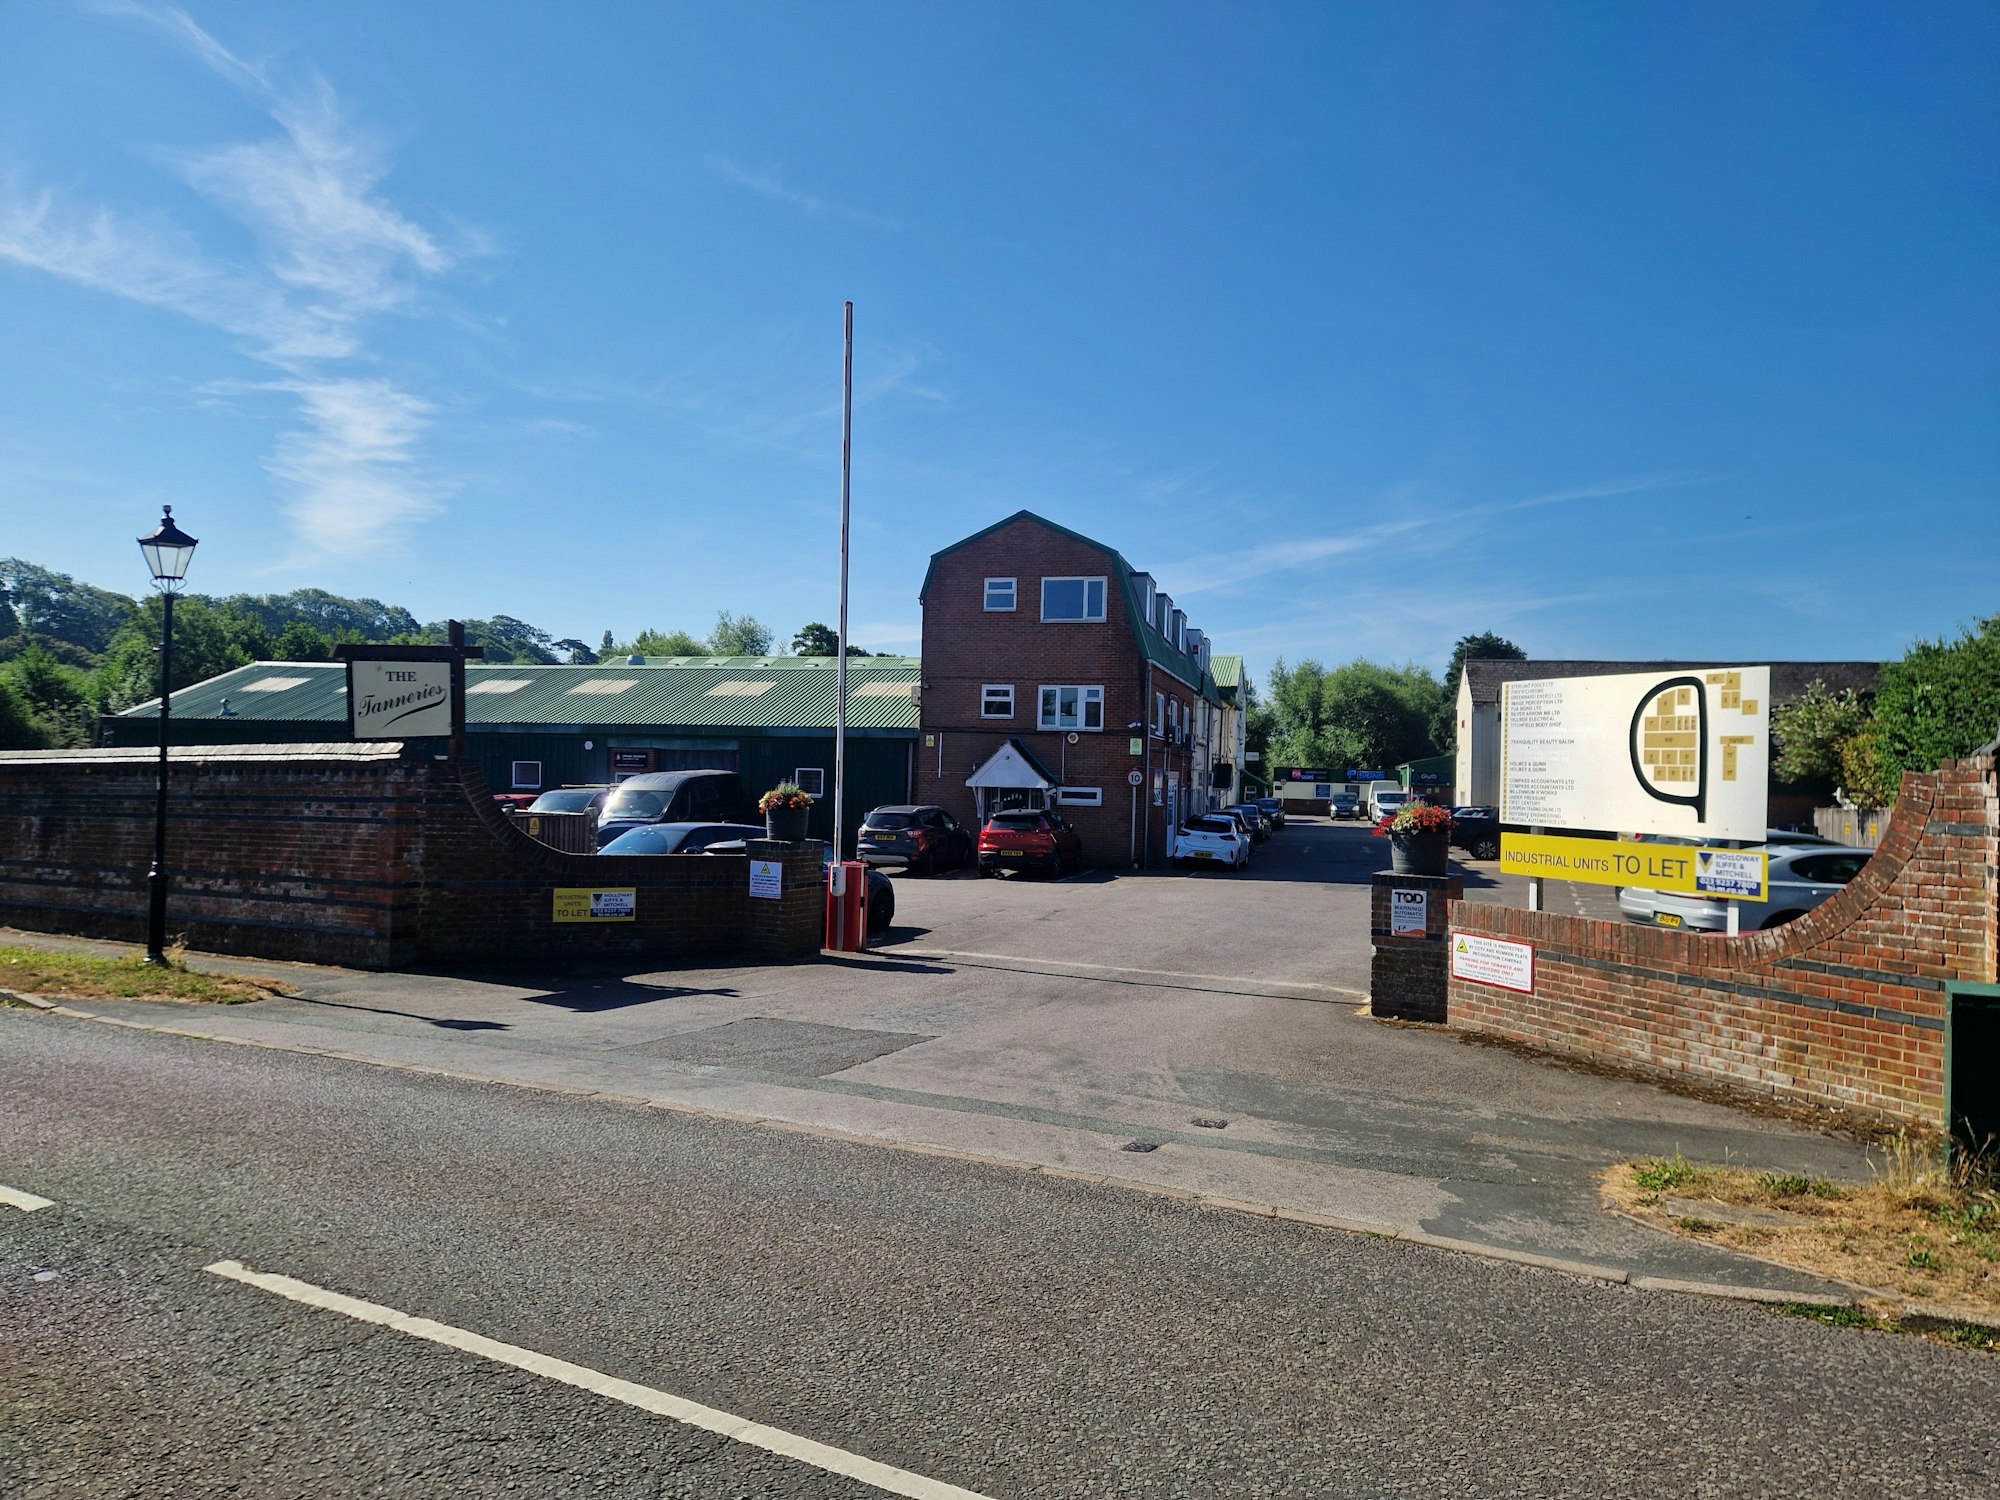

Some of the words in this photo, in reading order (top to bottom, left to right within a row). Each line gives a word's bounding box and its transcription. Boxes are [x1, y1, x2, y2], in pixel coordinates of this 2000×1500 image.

[385, 671, 416, 682] THE
[358, 683, 446, 718] Tanneries
[1130, 774, 1140, 782] 10
[1505, 851, 1570, 868] INDUSTRIAL
[1573, 858, 1609, 872] UNITS
[1612, 854, 1640, 874] TO
[1648, 858, 1688, 878] LET
[1716, 861, 1737, 870] ILIFFE
[1716, 870, 1752, 878] MITCHELL
[1699, 877, 1714, 885] 023
[1716, 878, 1736, 888] 9237
[1394, 892, 1424, 904] TOD
[1498, 943, 1524, 952] PROTECTED
[1472, 951, 1500, 960] RECOGNITION
[1502, 956, 1522, 964] CAMERAS
[1459, 956, 1479, 964] PARKING
[1490, 962, 1512, 971] TENANTS
[1479, 965, 1500, 974] VISITORS
